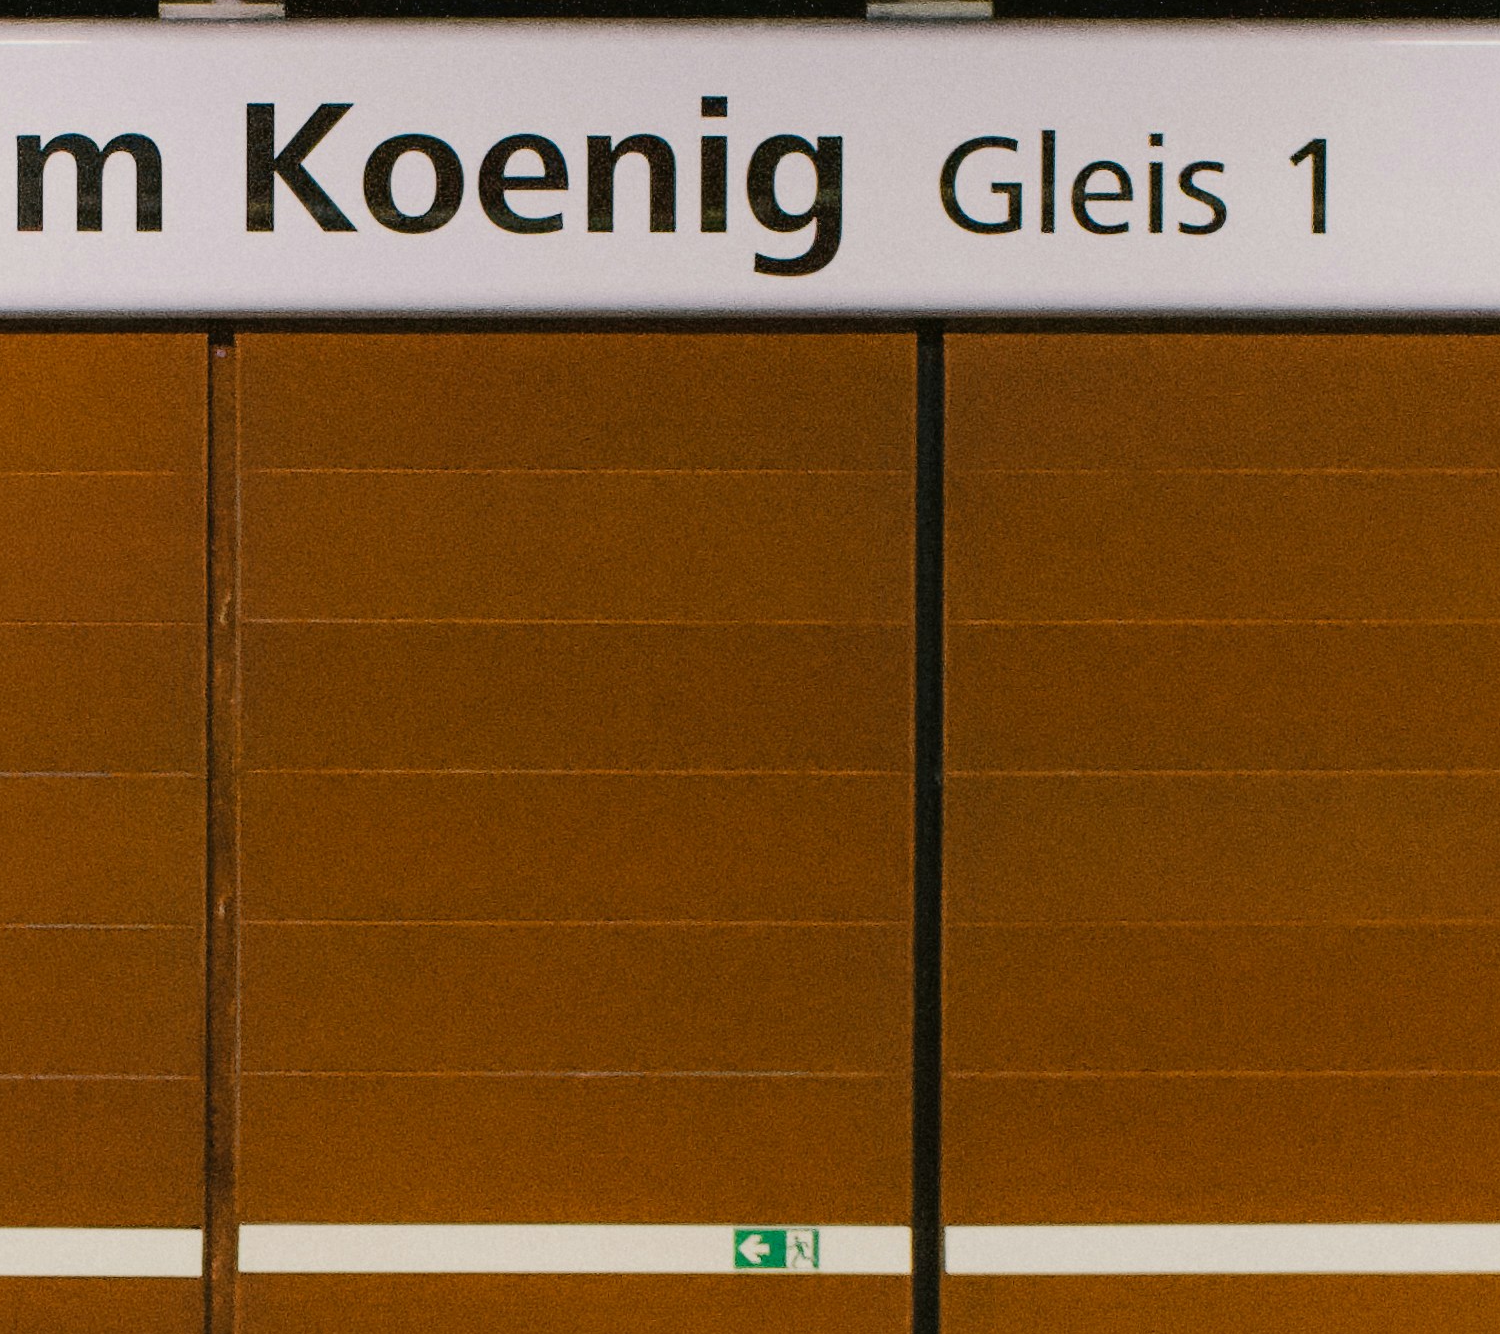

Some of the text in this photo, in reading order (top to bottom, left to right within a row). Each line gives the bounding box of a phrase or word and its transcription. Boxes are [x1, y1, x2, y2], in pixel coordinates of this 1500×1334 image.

[246, 95, 843, 277] Koenig
[939, 129, 1227, 236] Gleis
[1290, 138, 1327, 234] 1
